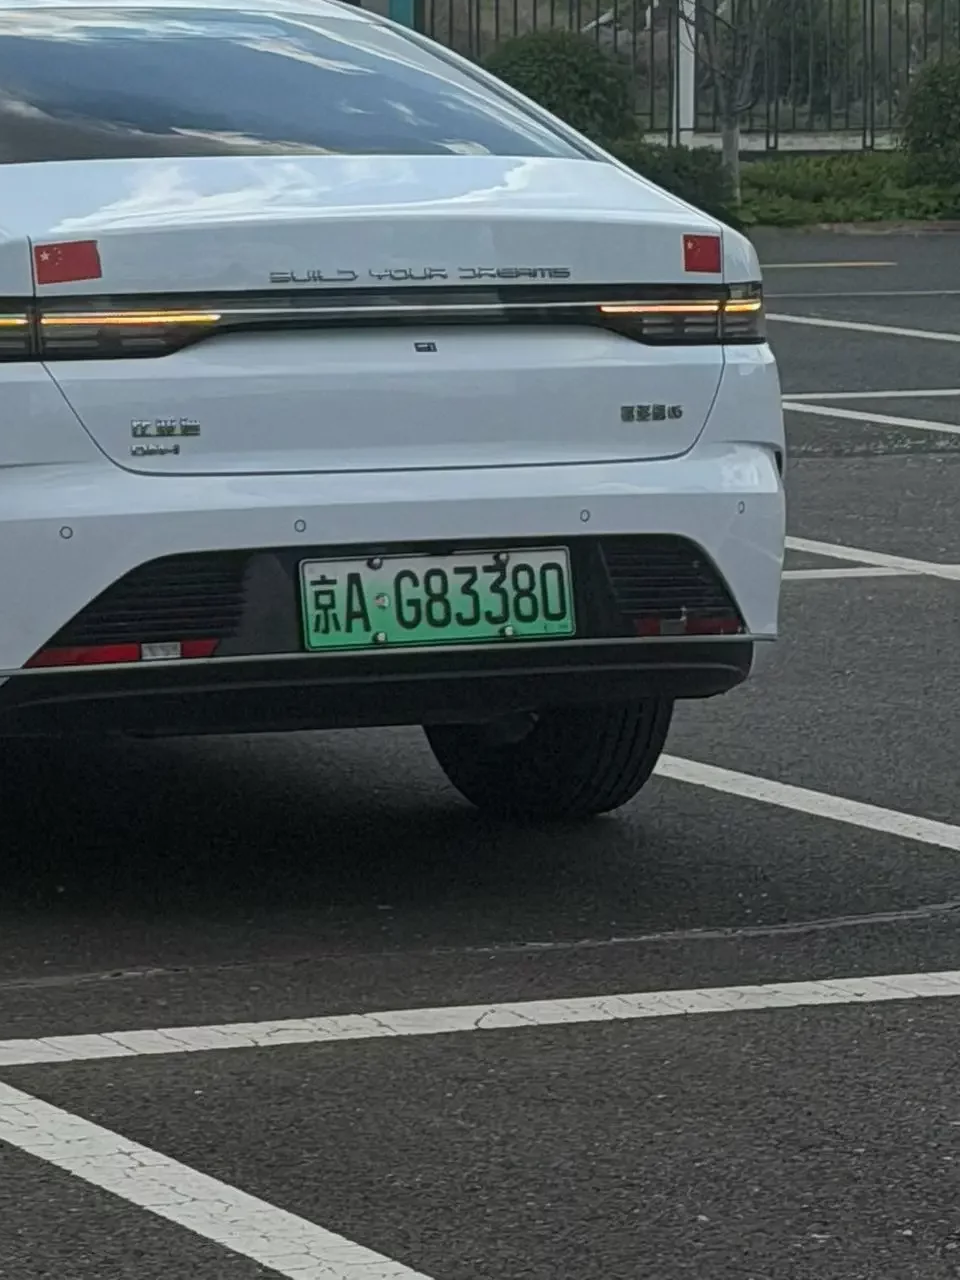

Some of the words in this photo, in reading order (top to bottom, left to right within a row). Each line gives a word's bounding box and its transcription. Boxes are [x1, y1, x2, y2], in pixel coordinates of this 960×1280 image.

[269, 269, 359, 284] BUILD
[368, 267, 448, 281] YOUR
[458, 266, 572, 280] DREAMS
